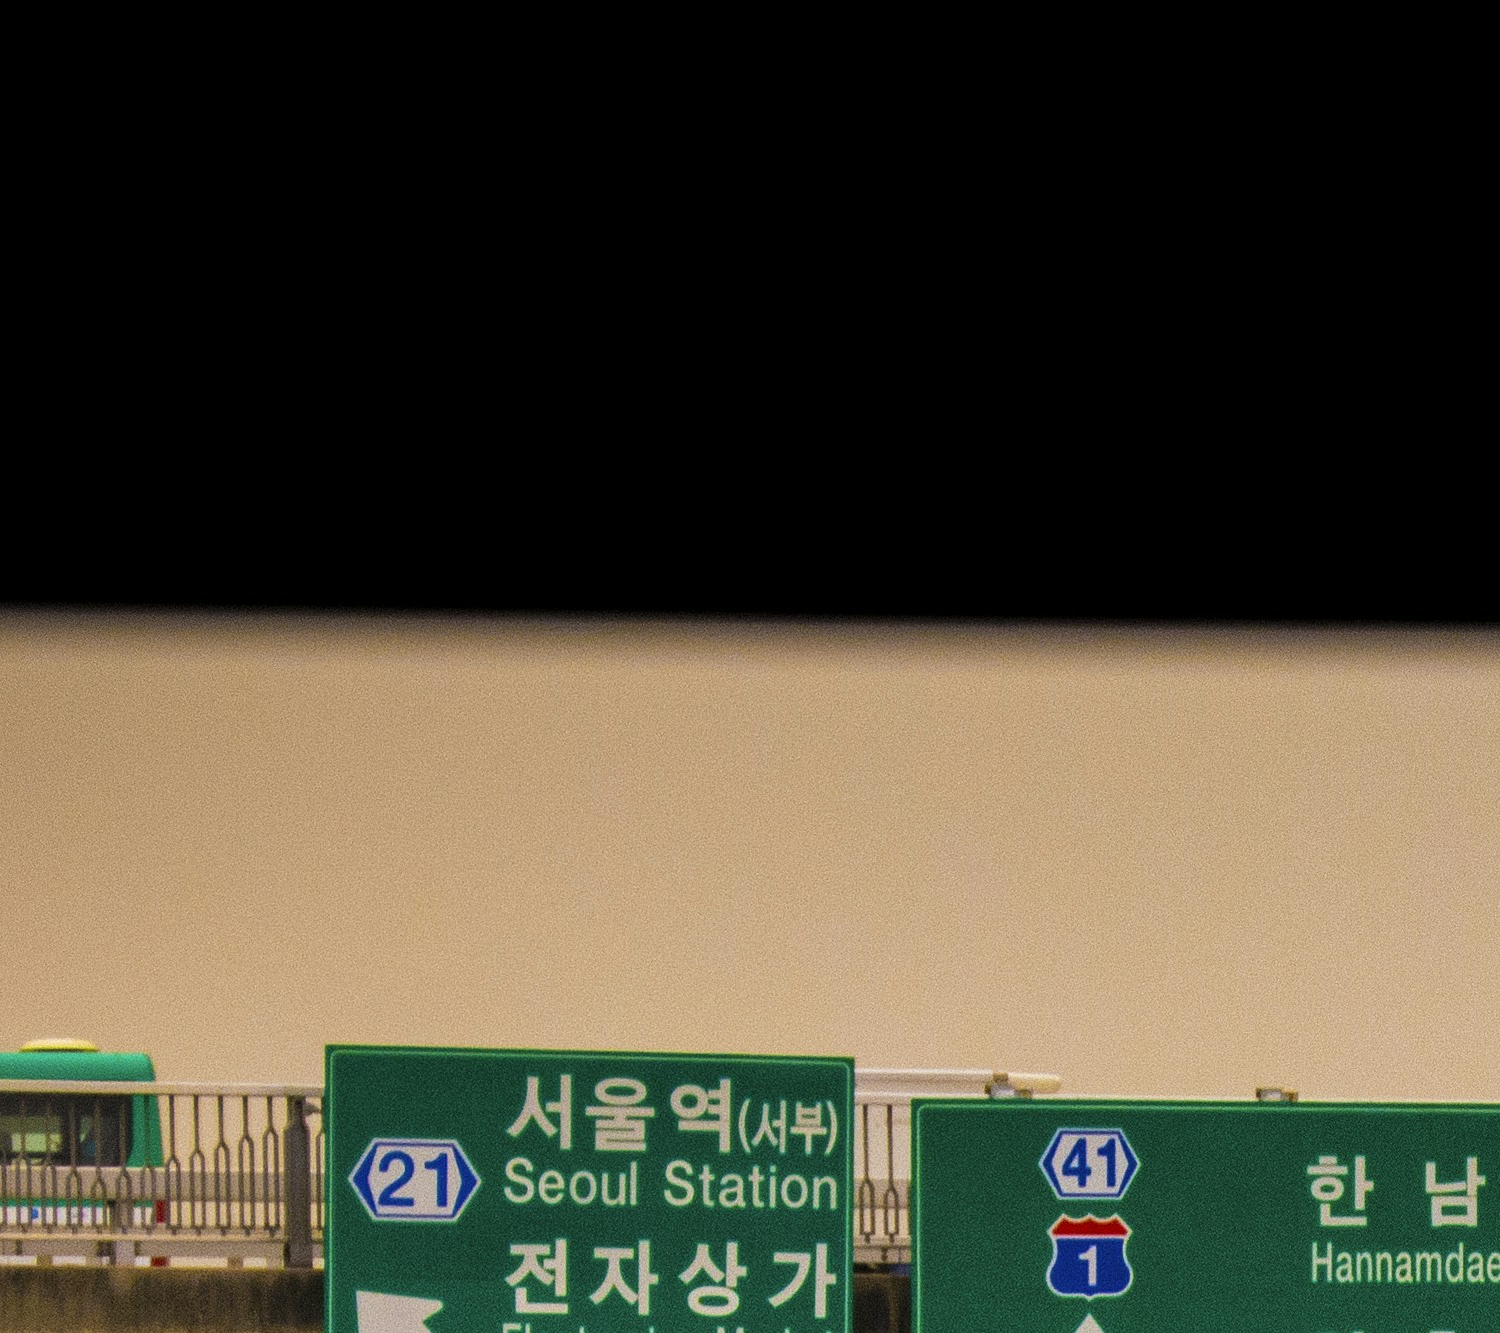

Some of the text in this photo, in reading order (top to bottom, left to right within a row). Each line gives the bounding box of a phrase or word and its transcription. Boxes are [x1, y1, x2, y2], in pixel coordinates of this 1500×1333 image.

[508, 1075, 837, 1154] 서울역(서부)
[378, 1151, 447, 1208] 21
[503, 1157, 837, 1209] Seoul Station
[1061, 1137, 1117, 1188] 41
[505, 1239, 837, 1319] 전자상가
[1078, 1245, 1098, 1286] 1
